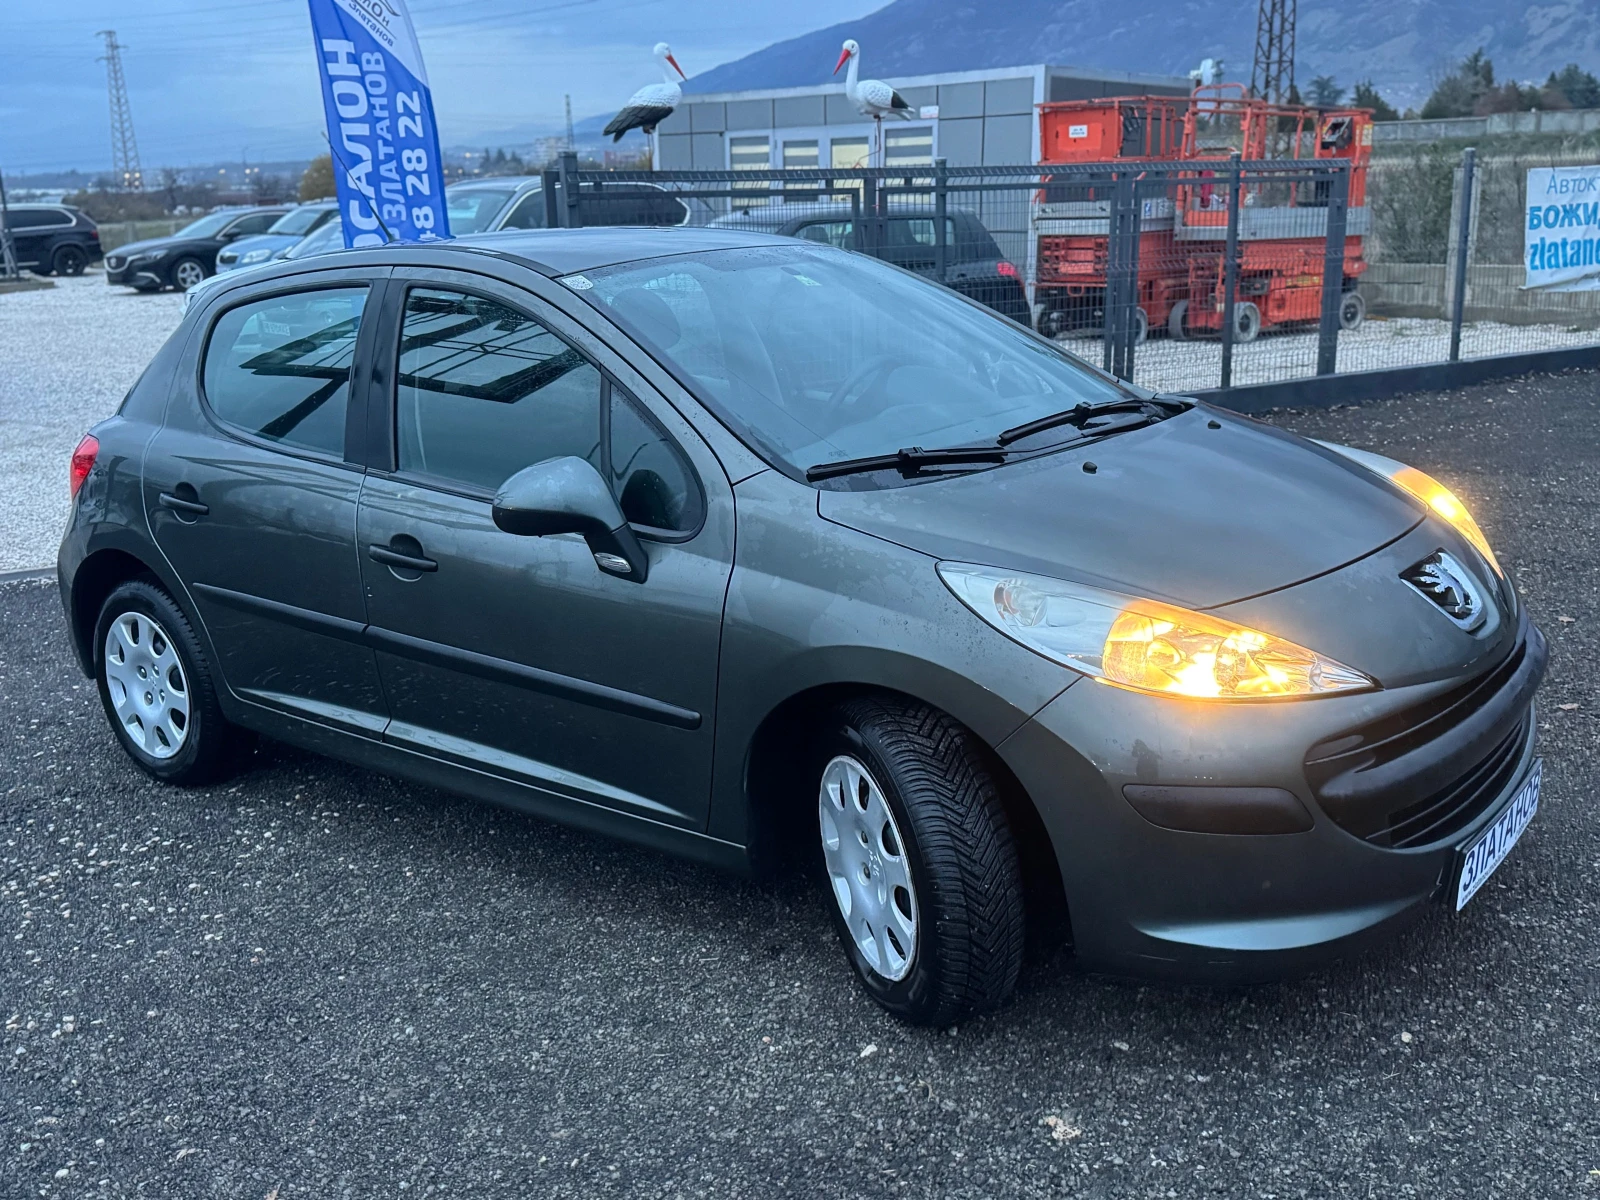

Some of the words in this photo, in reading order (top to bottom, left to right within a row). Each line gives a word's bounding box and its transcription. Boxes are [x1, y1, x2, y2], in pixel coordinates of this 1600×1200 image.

[348, 2, 394, 47] Златанов
[361, 51, 407, 221] ЗЛАТАНОВ
[396, 90, 424, 138] 22
[402, 148, 432, 196] 28
[1528, 201, 1600, 230] БОЖИ
[1463, 768, 1540, 892] ЗЛАТАНОВ
